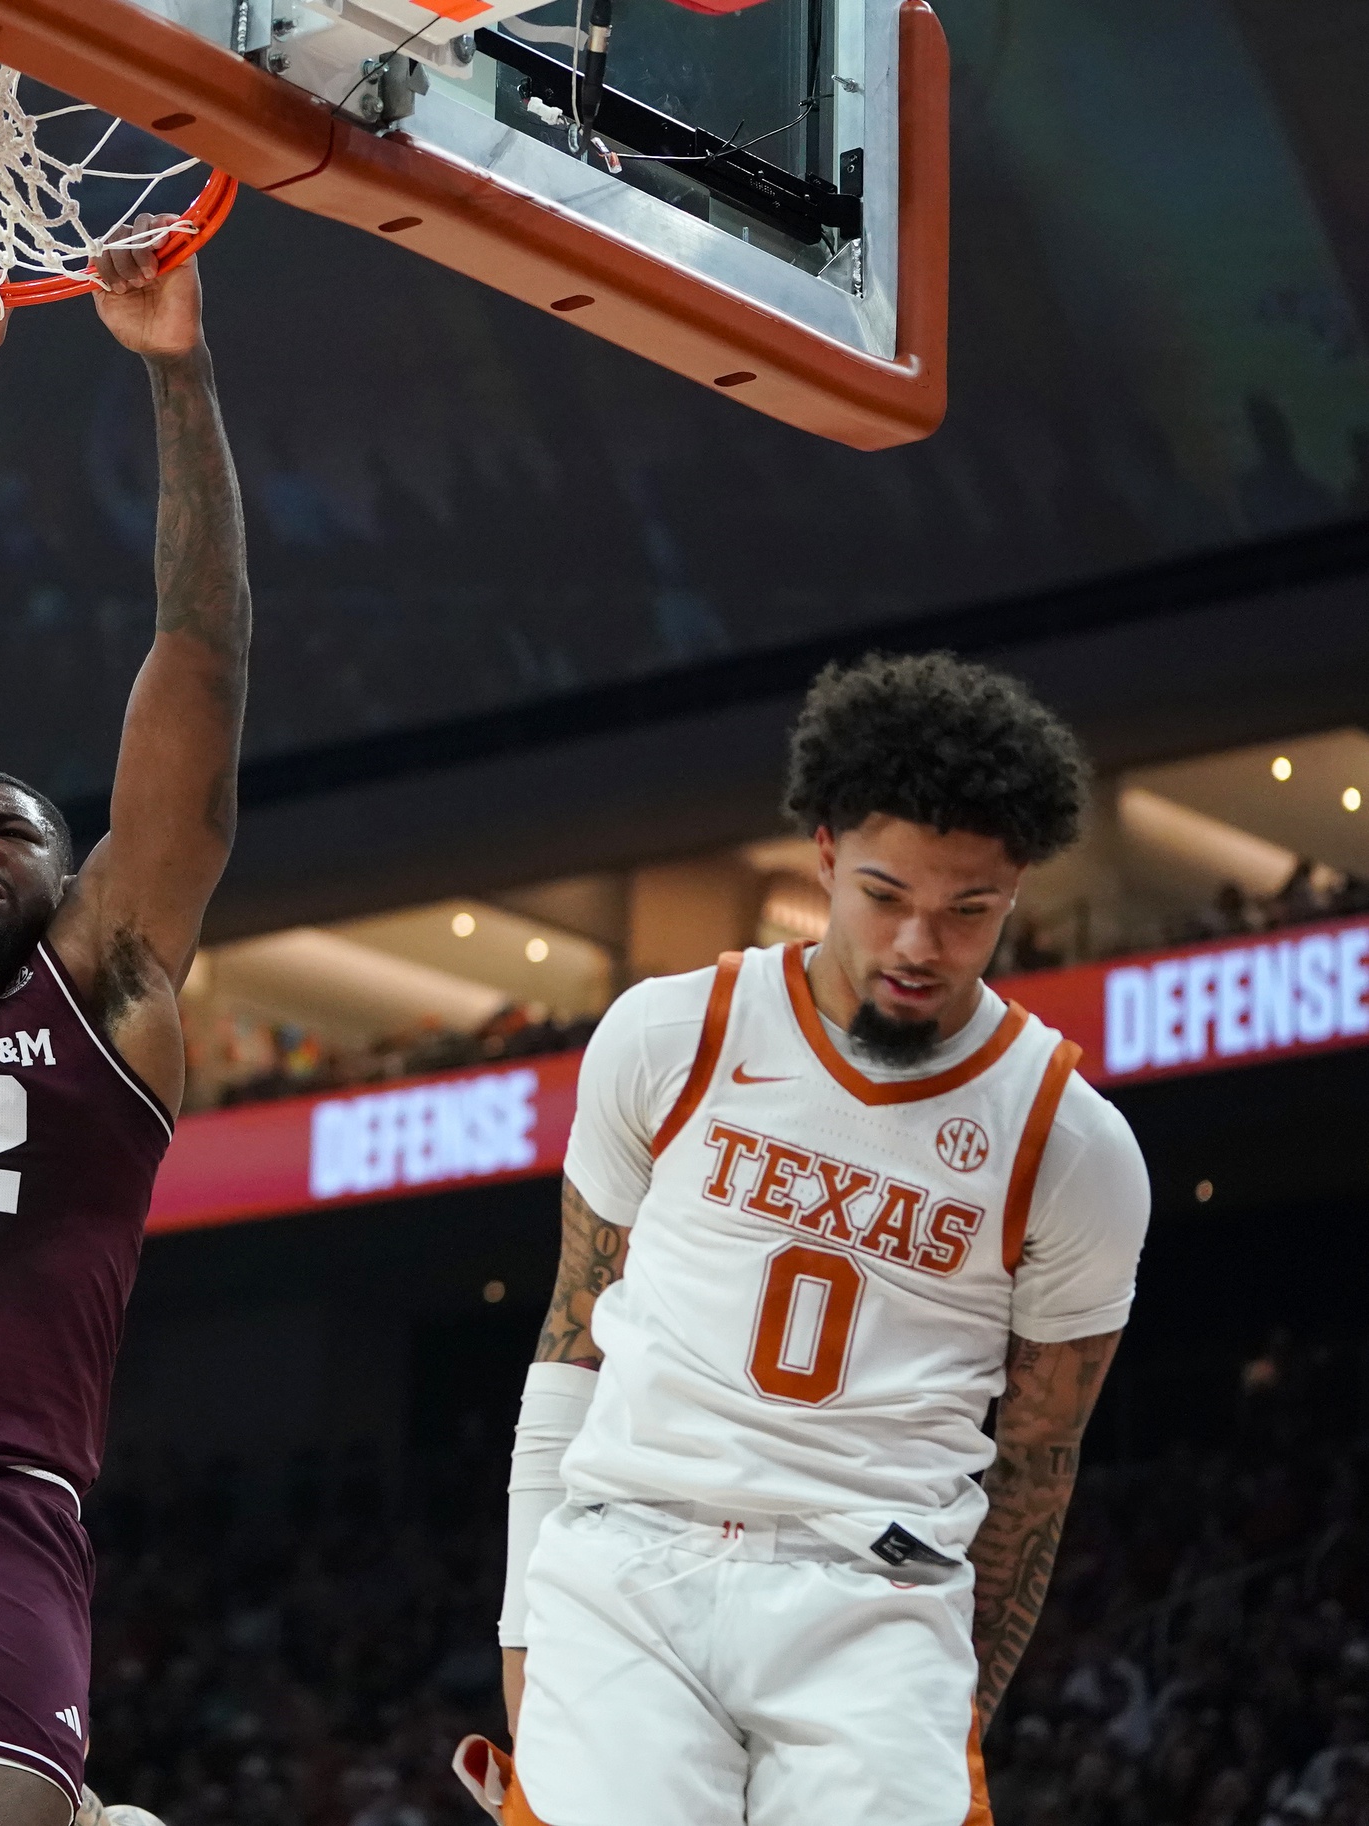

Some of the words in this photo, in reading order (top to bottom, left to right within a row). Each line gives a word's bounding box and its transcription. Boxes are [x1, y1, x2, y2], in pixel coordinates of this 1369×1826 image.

[1104, 926, 1369, 1075] DEFENSE
[310, 1069, 538, 1199] DEFENSE
[702, 1119, 985, 1278] TEXAS
[936, 1118, 989, 1172] SEC
[745, 1239, 867, 1408] 0
